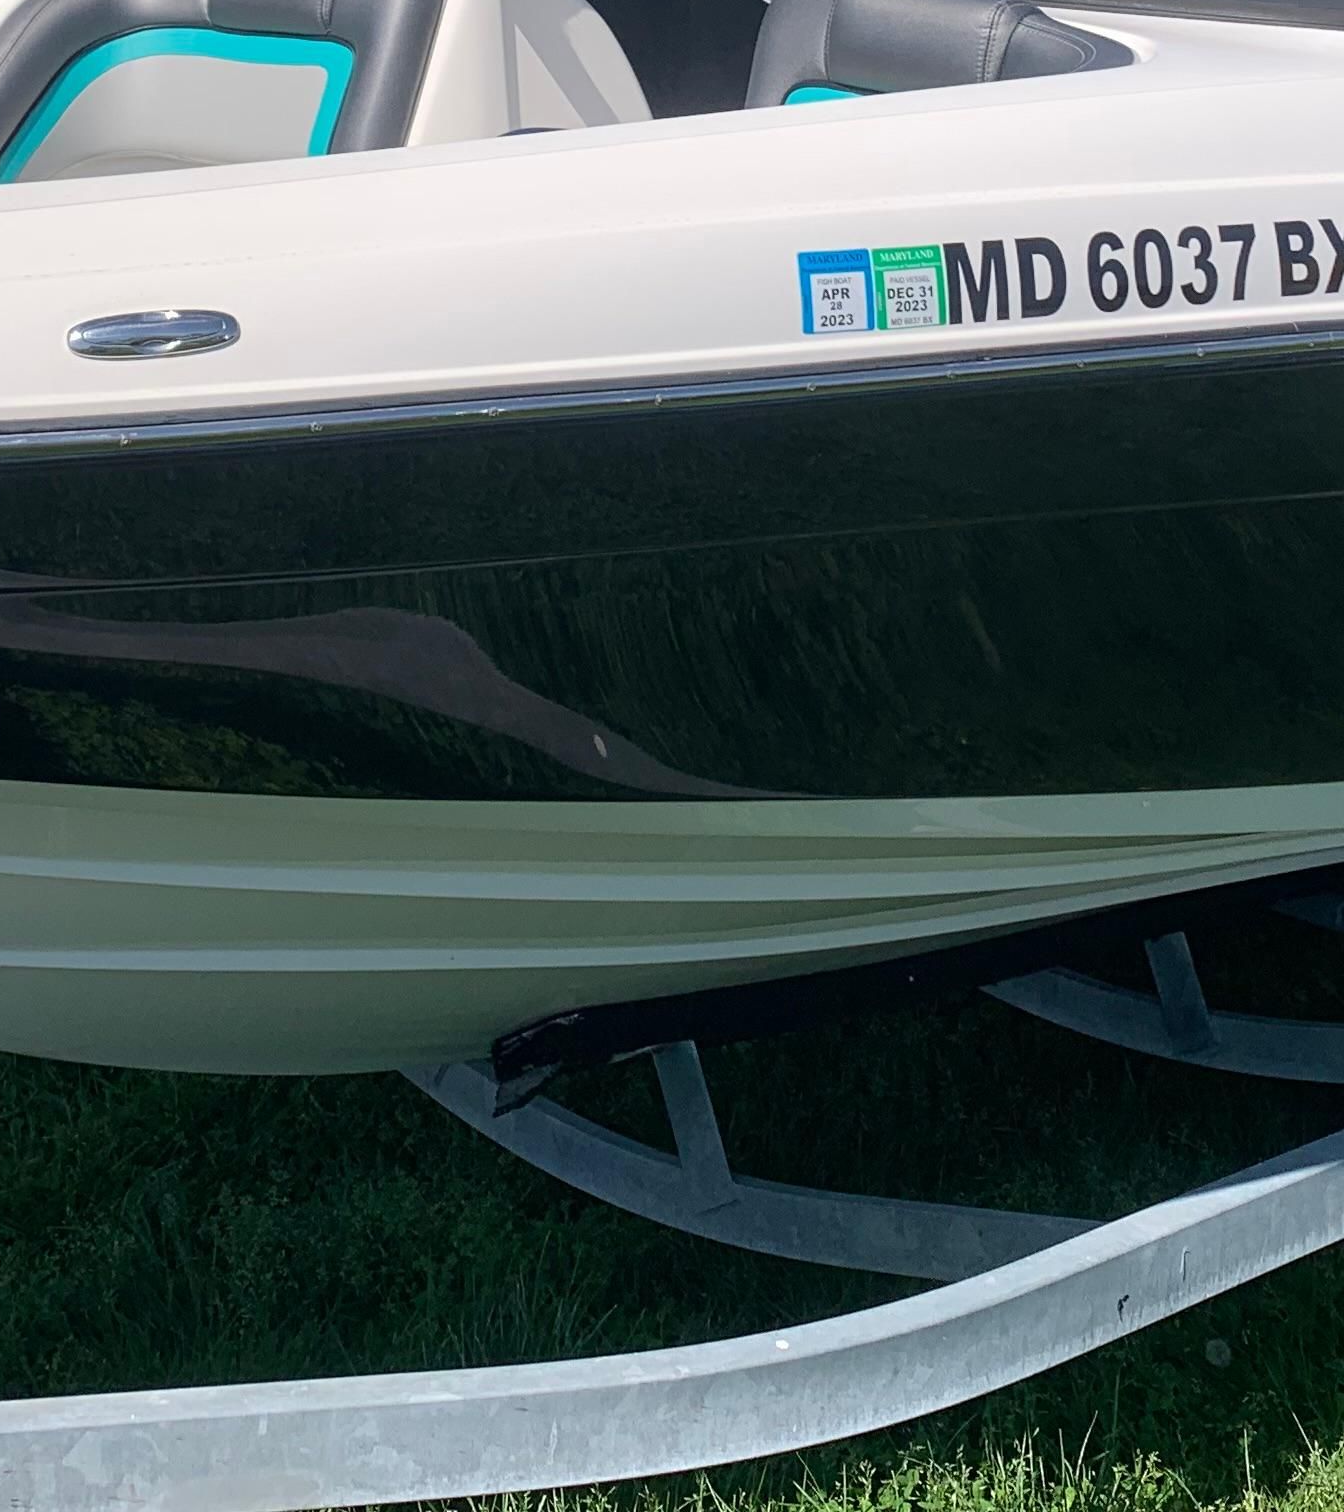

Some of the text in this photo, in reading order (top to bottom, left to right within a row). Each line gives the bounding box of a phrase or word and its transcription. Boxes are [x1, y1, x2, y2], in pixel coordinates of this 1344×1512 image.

[807, 253, 863, 265] MARYLAND
[879, 249, 934, 263] MARYLAND
[943, 236, 1067, 325] MD
[1087, 224, 1256, 313] 6037
[821, 287, 851, 300] APR
[887, 285, 934, 299] DEC 31
[830, 300, 843, 311] 28
[895, 299, 928, 313] 2023
[820, 313, 854, 327] 2023
